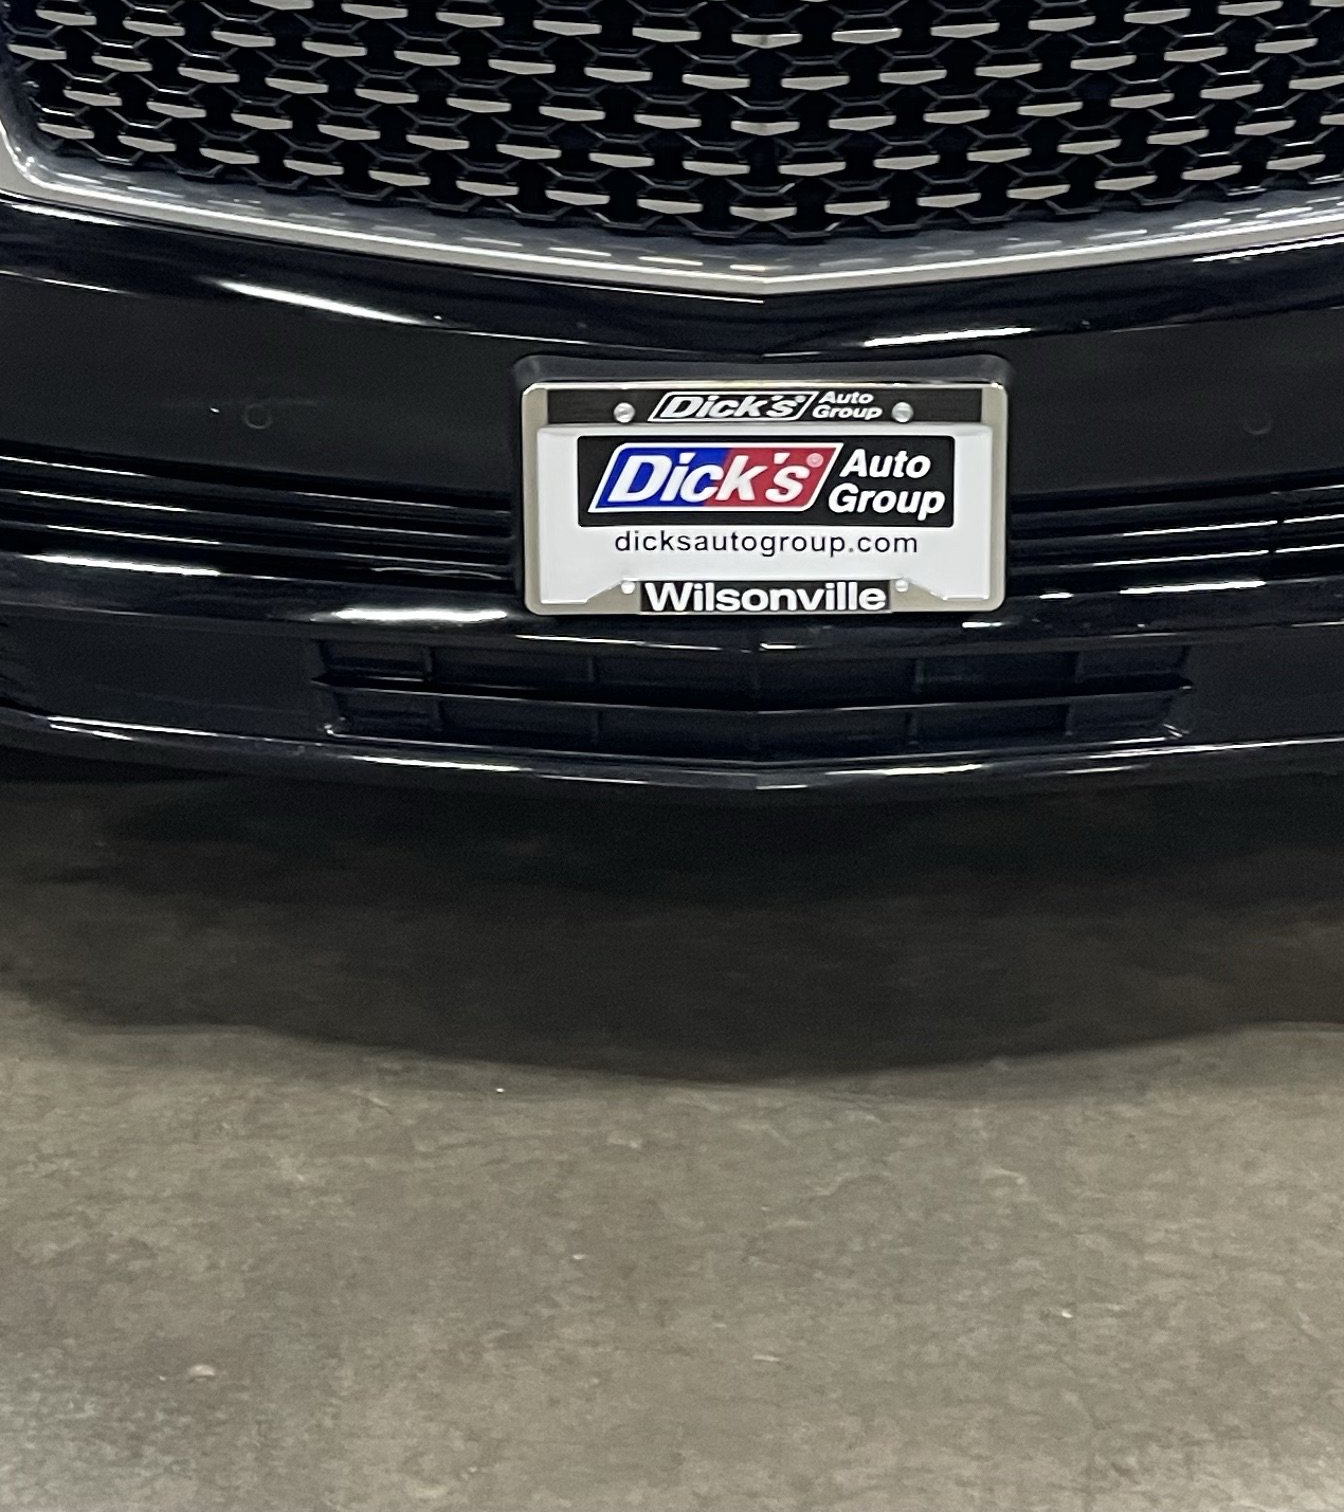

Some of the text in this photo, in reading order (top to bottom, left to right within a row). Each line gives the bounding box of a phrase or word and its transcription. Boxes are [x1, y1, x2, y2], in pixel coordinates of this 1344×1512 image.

[660, 395, 798, 419] Dick's
[819, 391, 874, 404] Auto
[812, 405, 883, 420] Group
[607, 451, 810, 504] Dick's
[840, 449, 931, 479] Auto
[828, 483, 945, 521] Group
[615, 531, 918, 557] dicksautogroup.com
[644, 581, 886, 612] Wilsonville
